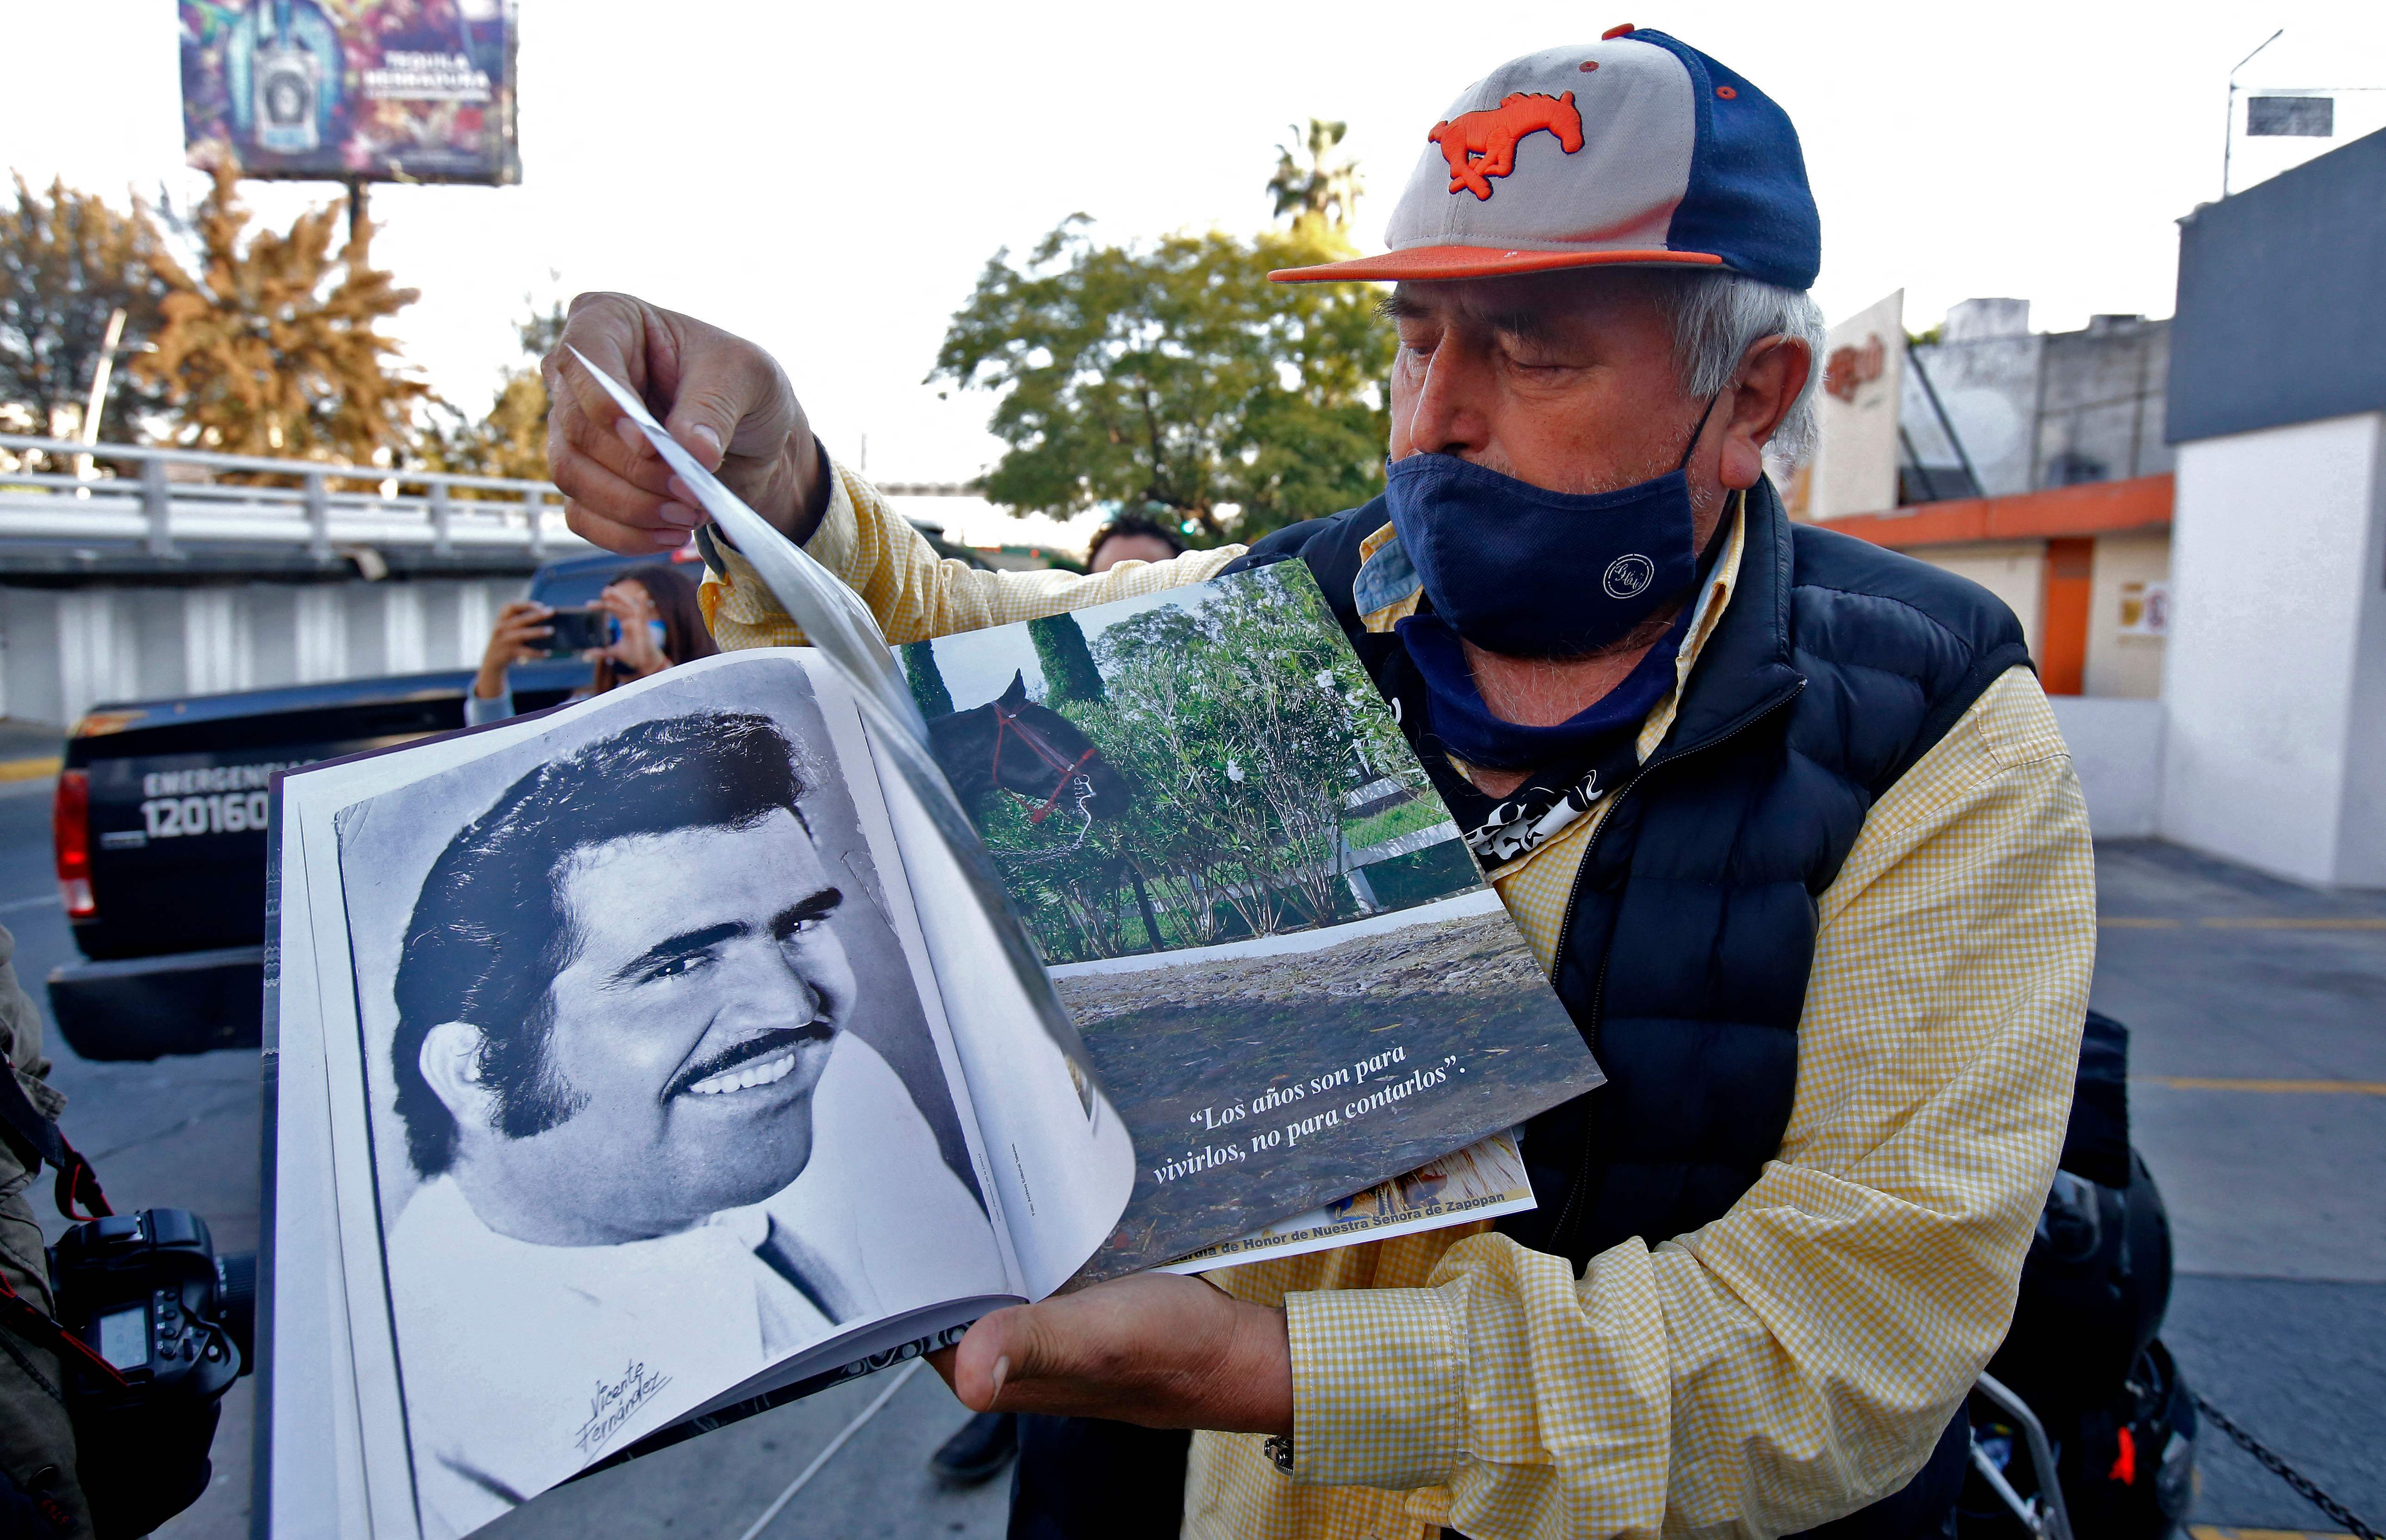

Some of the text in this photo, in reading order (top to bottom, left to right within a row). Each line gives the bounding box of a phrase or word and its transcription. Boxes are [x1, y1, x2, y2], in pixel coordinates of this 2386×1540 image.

[1153, 1055, 1466, 1185] vivirlos, no para contarlos”.
[1190, 1046, 1407, 1131] “Los años son para
[1221, 1243, 1240, 1253] de
[1243, 1234, 1287, 1249] Honor
[1291, 1230, 1308, 1241] de
[1312, 1221, 1369, 1236] Nuestra
[1425, 1205, 1443, 1216] de
[1445, 1192, 1505, 1211] Zapopan
